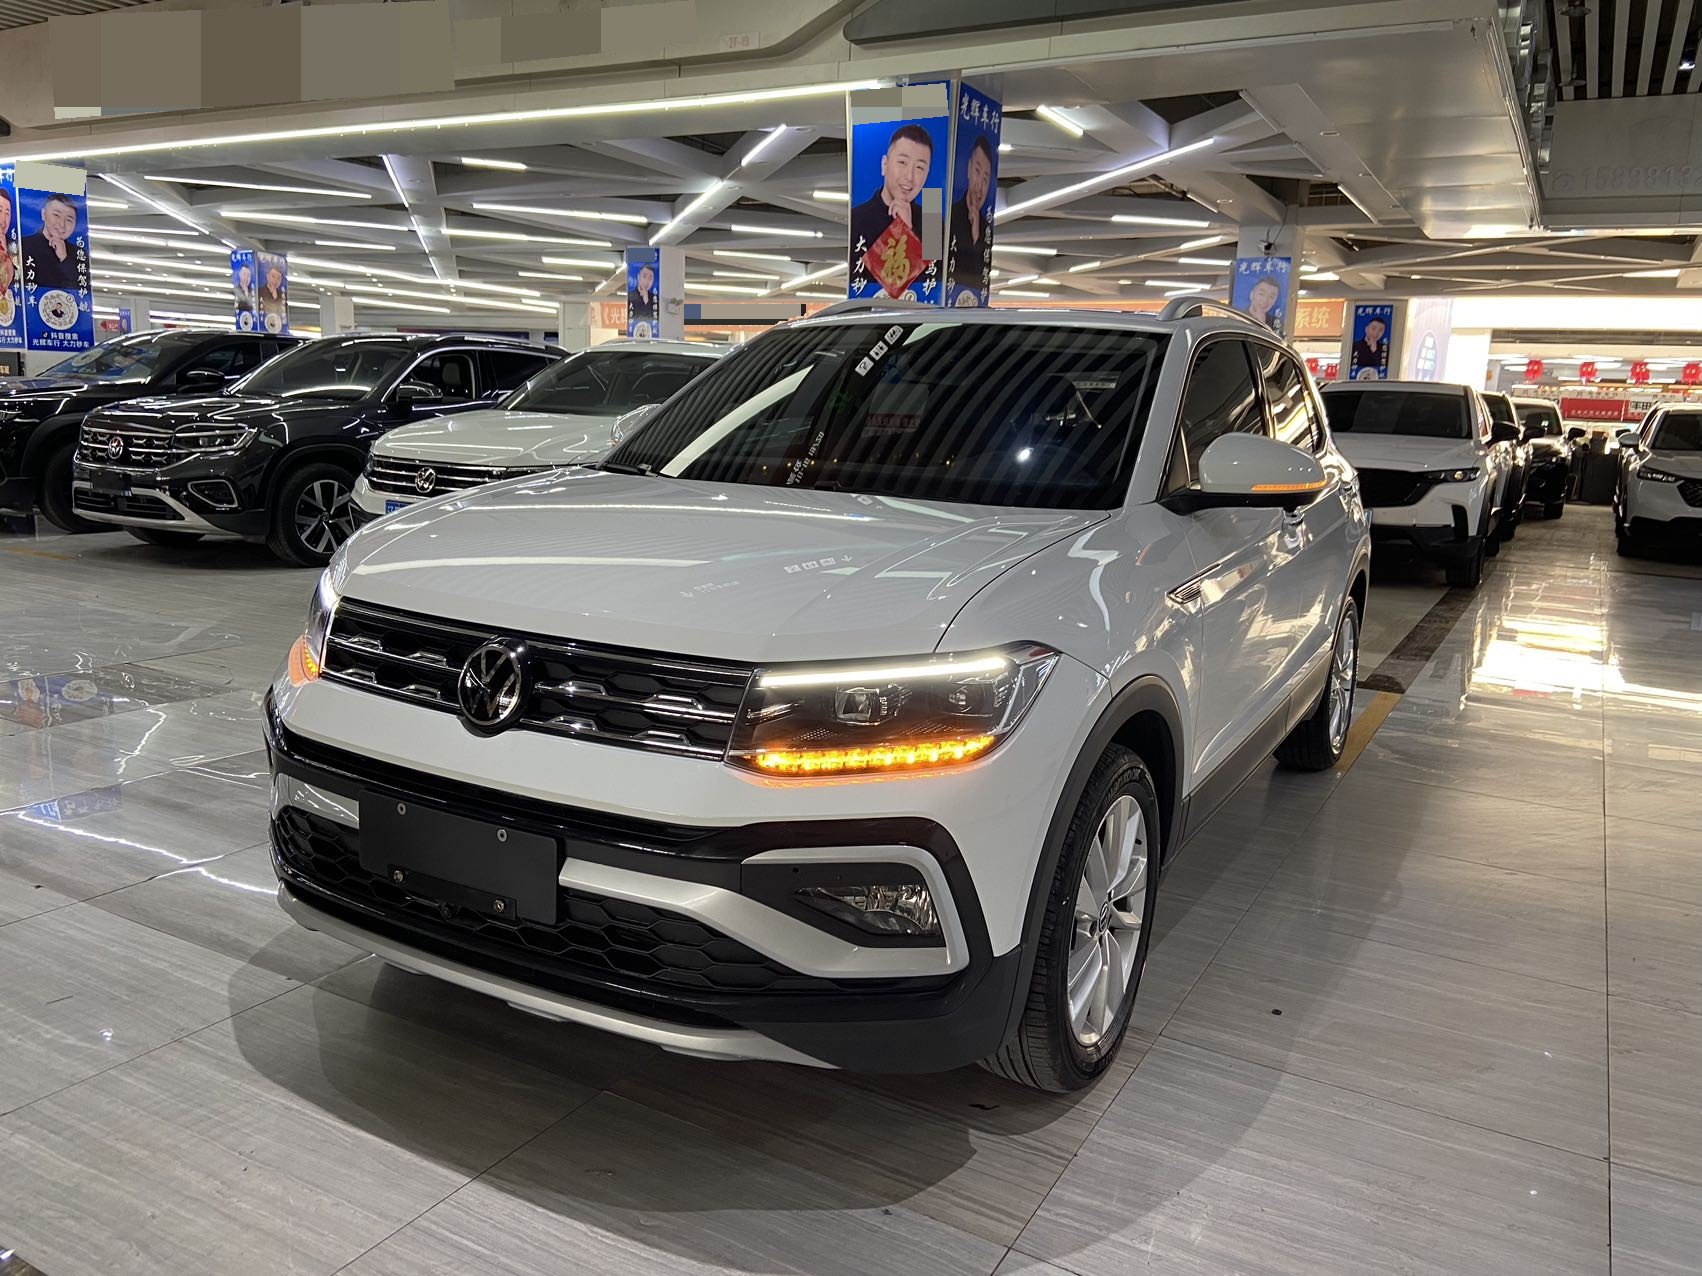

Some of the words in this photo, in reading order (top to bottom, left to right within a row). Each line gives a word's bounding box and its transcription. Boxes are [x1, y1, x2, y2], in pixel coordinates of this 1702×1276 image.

[25, 255, 38, 308] 大力秒车
[76, 235, 91, 313] 为您保驾护航
[880, 233, 911, 289] 福
[1239, 260, 1289, 275] 光辉车行
